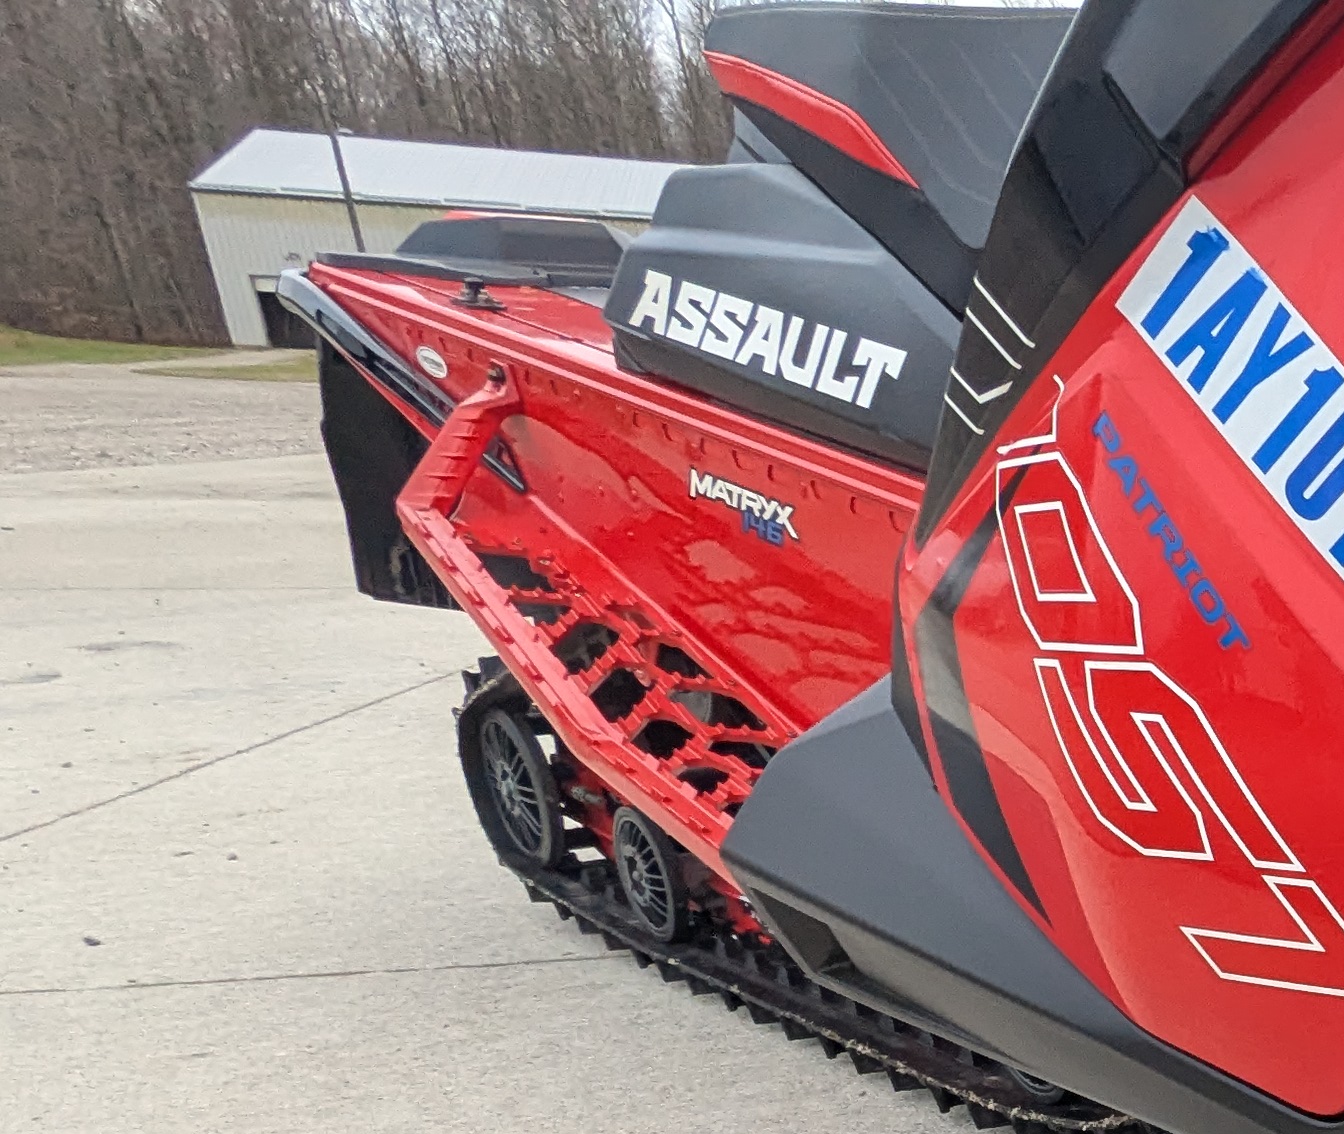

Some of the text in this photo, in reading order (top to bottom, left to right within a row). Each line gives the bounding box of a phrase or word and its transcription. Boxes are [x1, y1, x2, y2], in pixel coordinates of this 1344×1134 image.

[628, 269, 908, 409] ASSAULT
[688, 468, 800, 540] MATRYX
[742, 511, 784, 546] 146
[1092, 410, 1252, 650] PATRIOT
